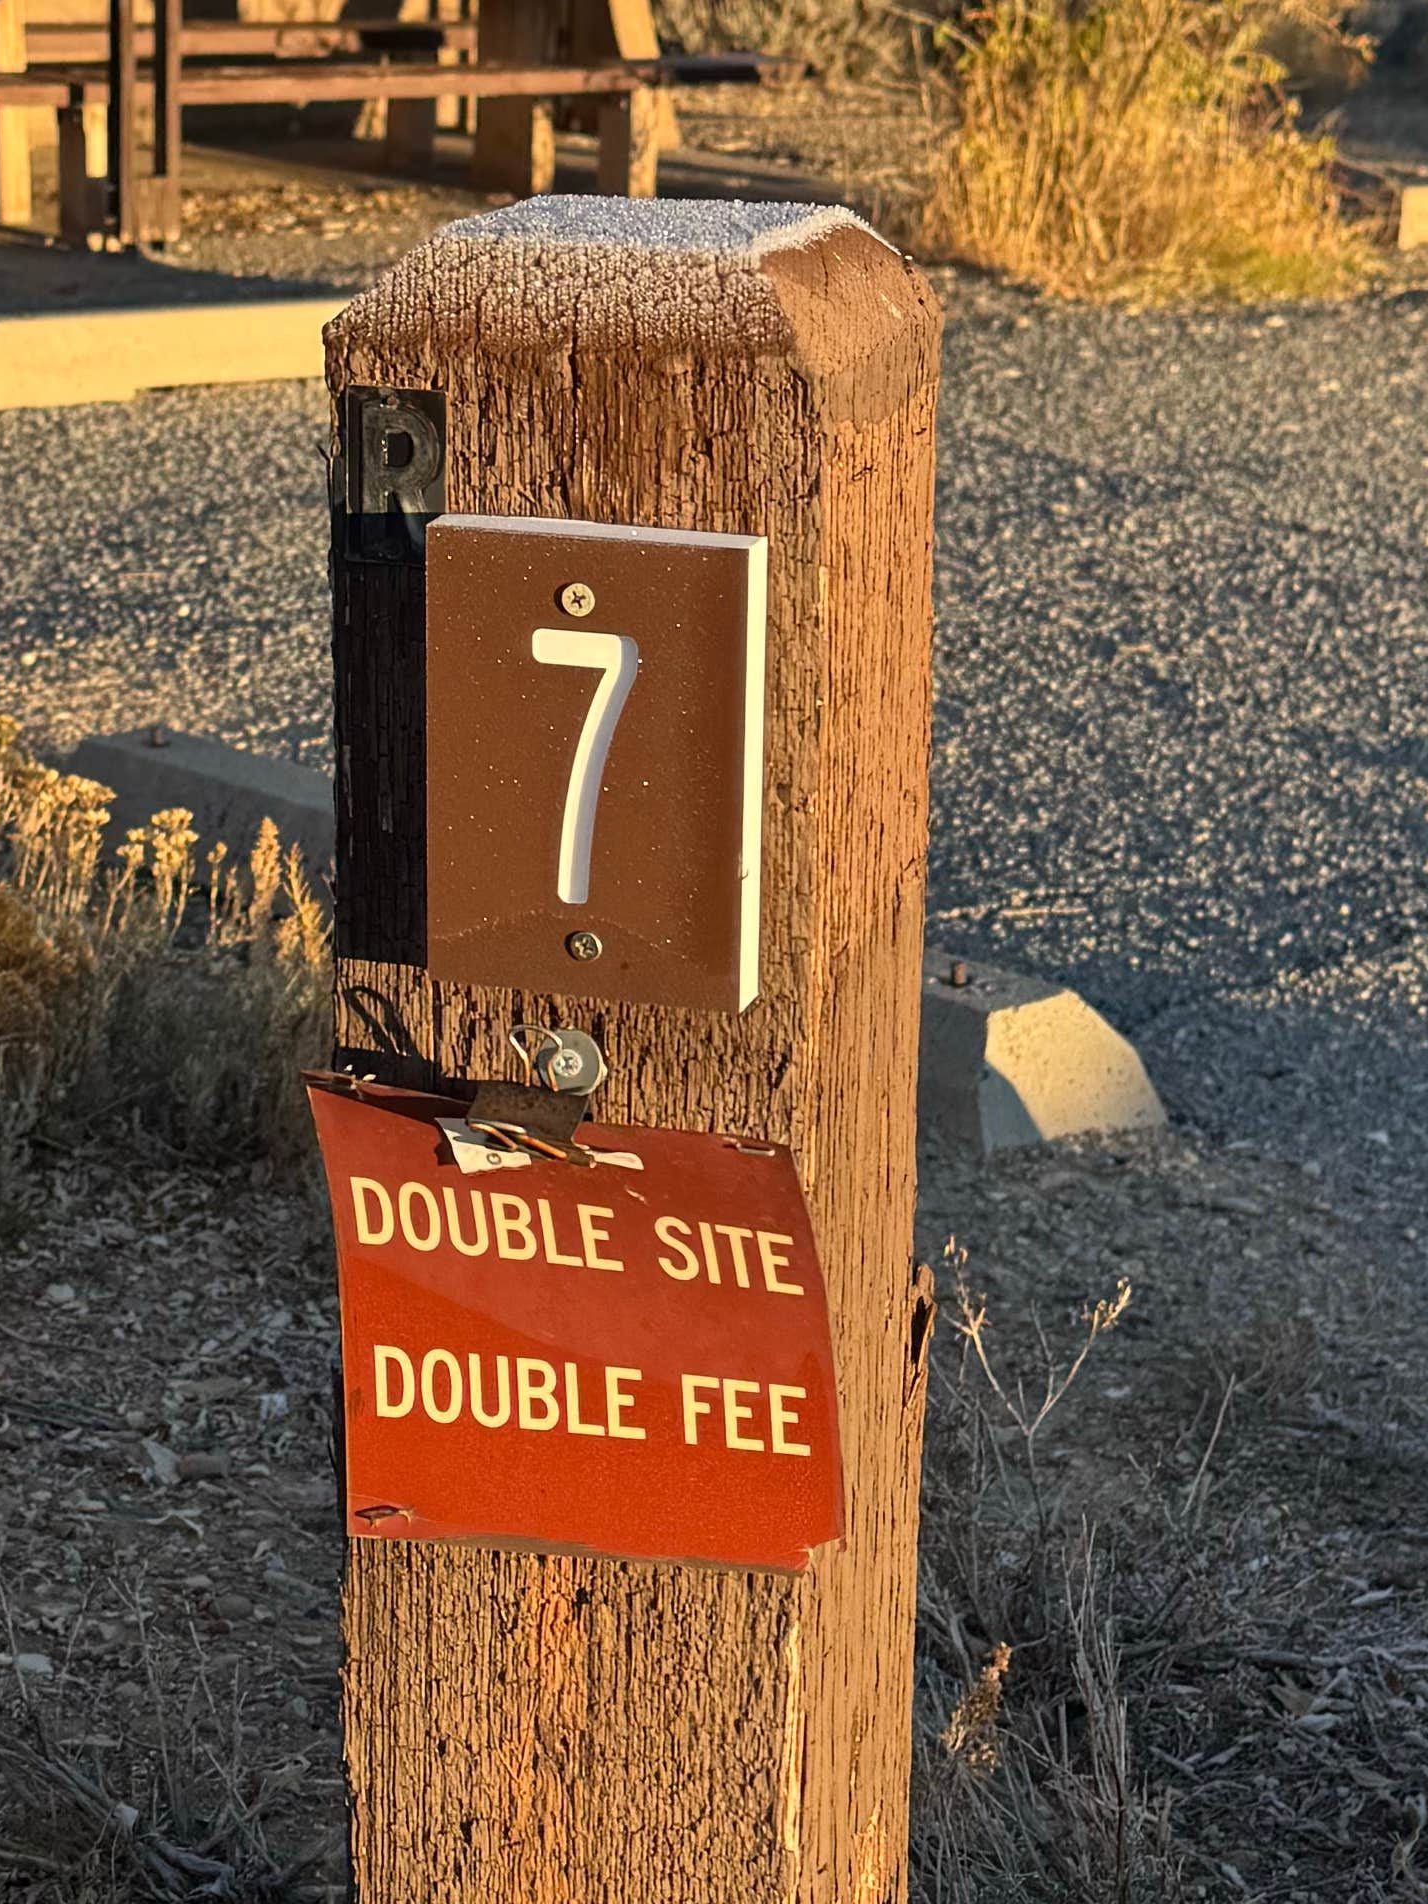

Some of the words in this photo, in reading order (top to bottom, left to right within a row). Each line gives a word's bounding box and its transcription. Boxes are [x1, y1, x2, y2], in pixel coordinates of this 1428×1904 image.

[531, 627, 639, 905] 7
[350, 1176, 624, 1272] DOUBLE
[654, 1216, 805, 1296] SITE
[373, 1344, 646, 1440] DOUBLE
[681, 1374, 811, 1457] FEE
